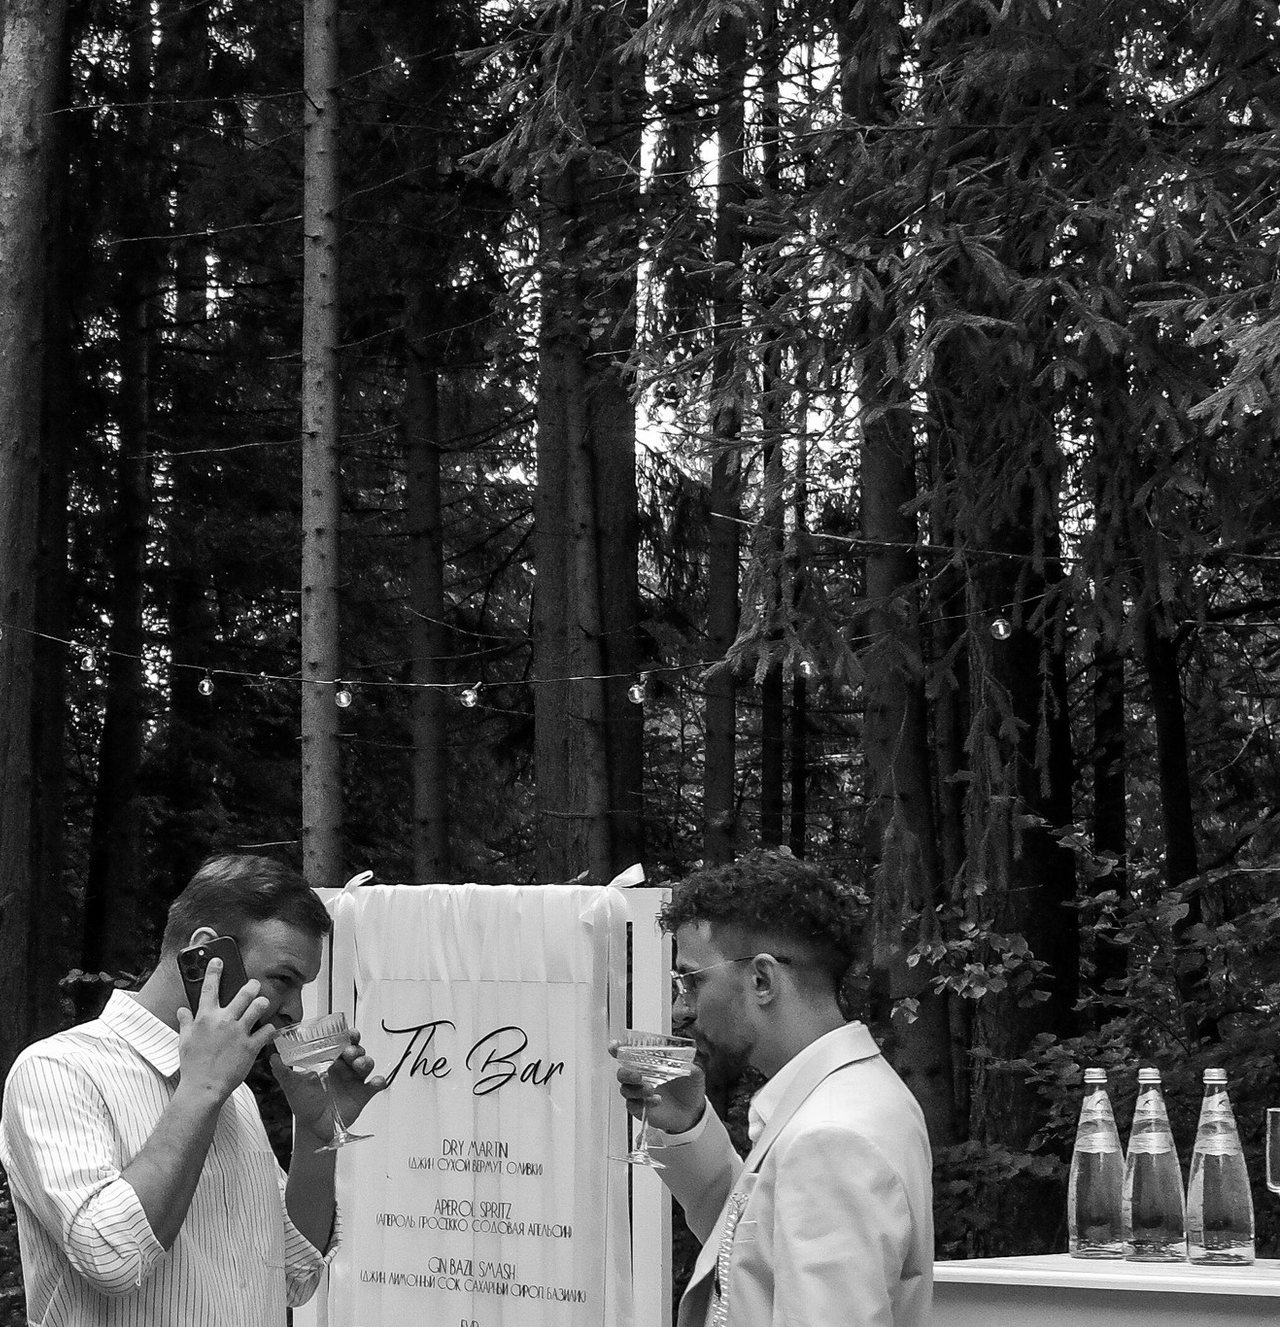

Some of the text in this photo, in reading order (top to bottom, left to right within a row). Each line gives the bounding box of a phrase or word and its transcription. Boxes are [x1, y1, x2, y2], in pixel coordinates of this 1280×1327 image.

[381, 1018, 565, 1096] The Bar
[442, 1138, 465, 1157] DRY
[433, 1198, 512, 1220] APEROL SPRITZ
[478, 1260, 516, 1281] SMASH
